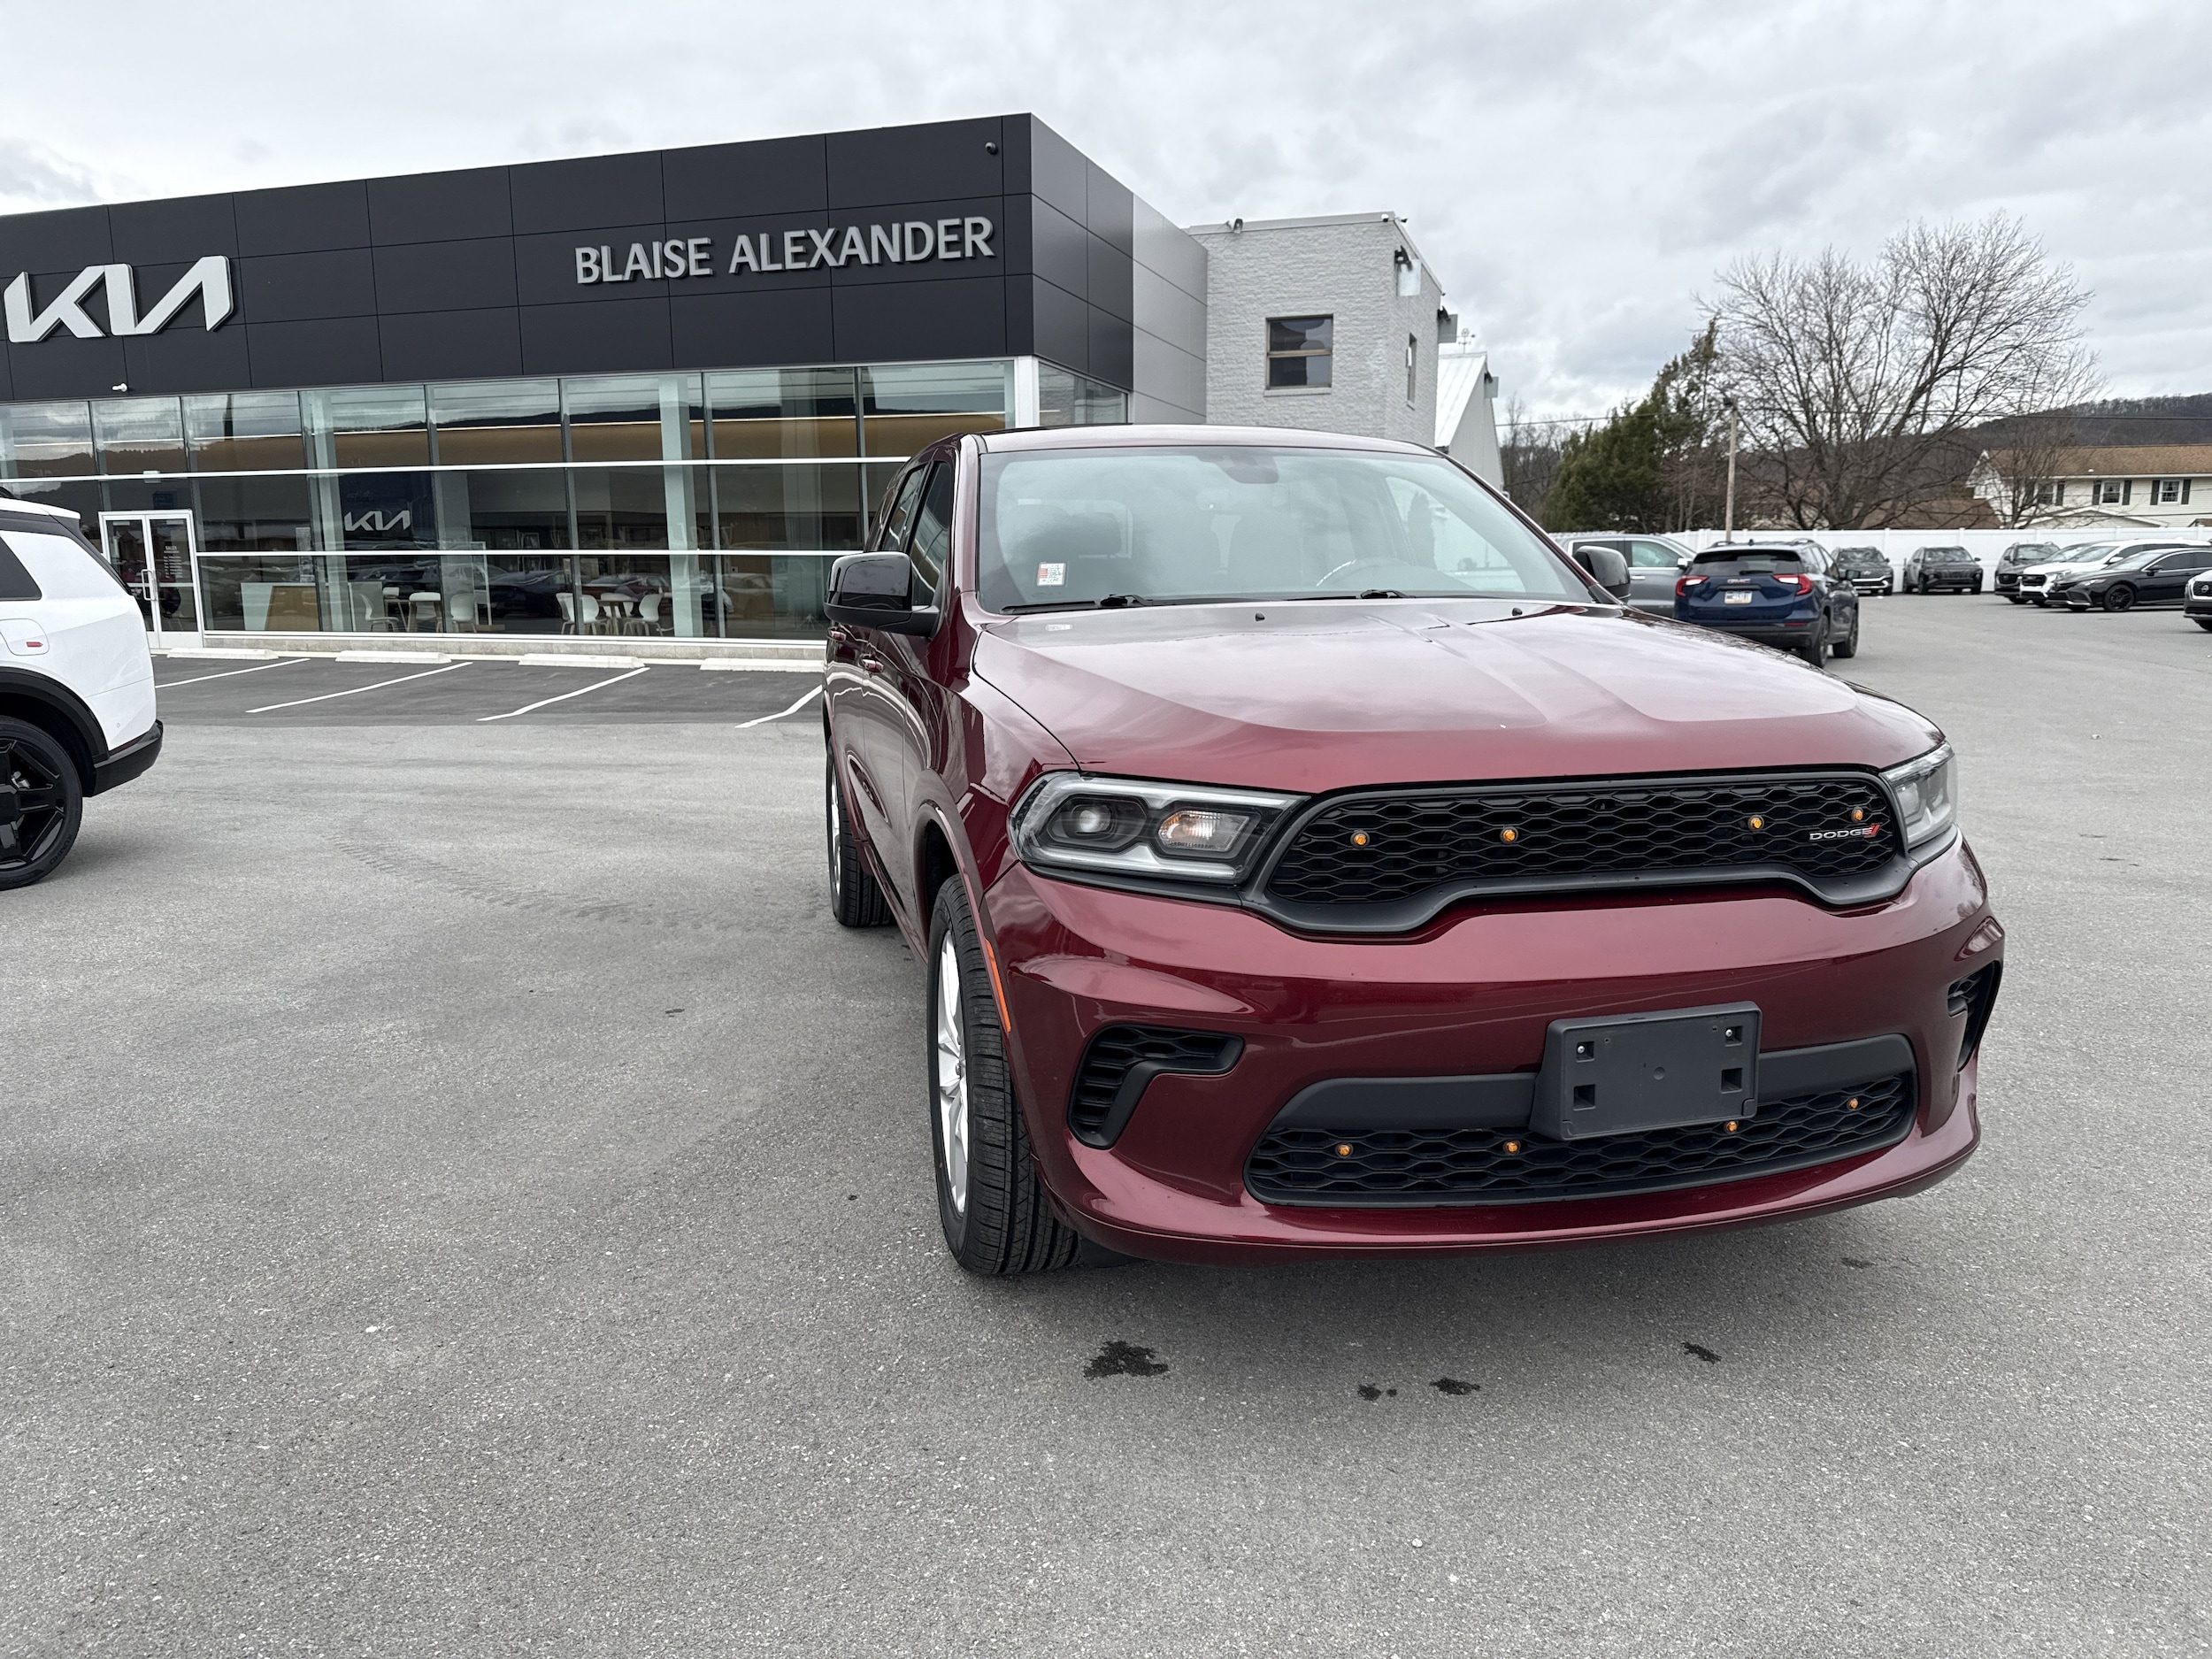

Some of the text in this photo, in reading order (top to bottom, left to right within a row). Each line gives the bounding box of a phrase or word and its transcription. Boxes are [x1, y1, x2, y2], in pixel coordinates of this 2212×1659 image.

[574, 216, 995, 284] BLAISE ALEXANDER
[1809, 826, 1875, 840] DODGE
